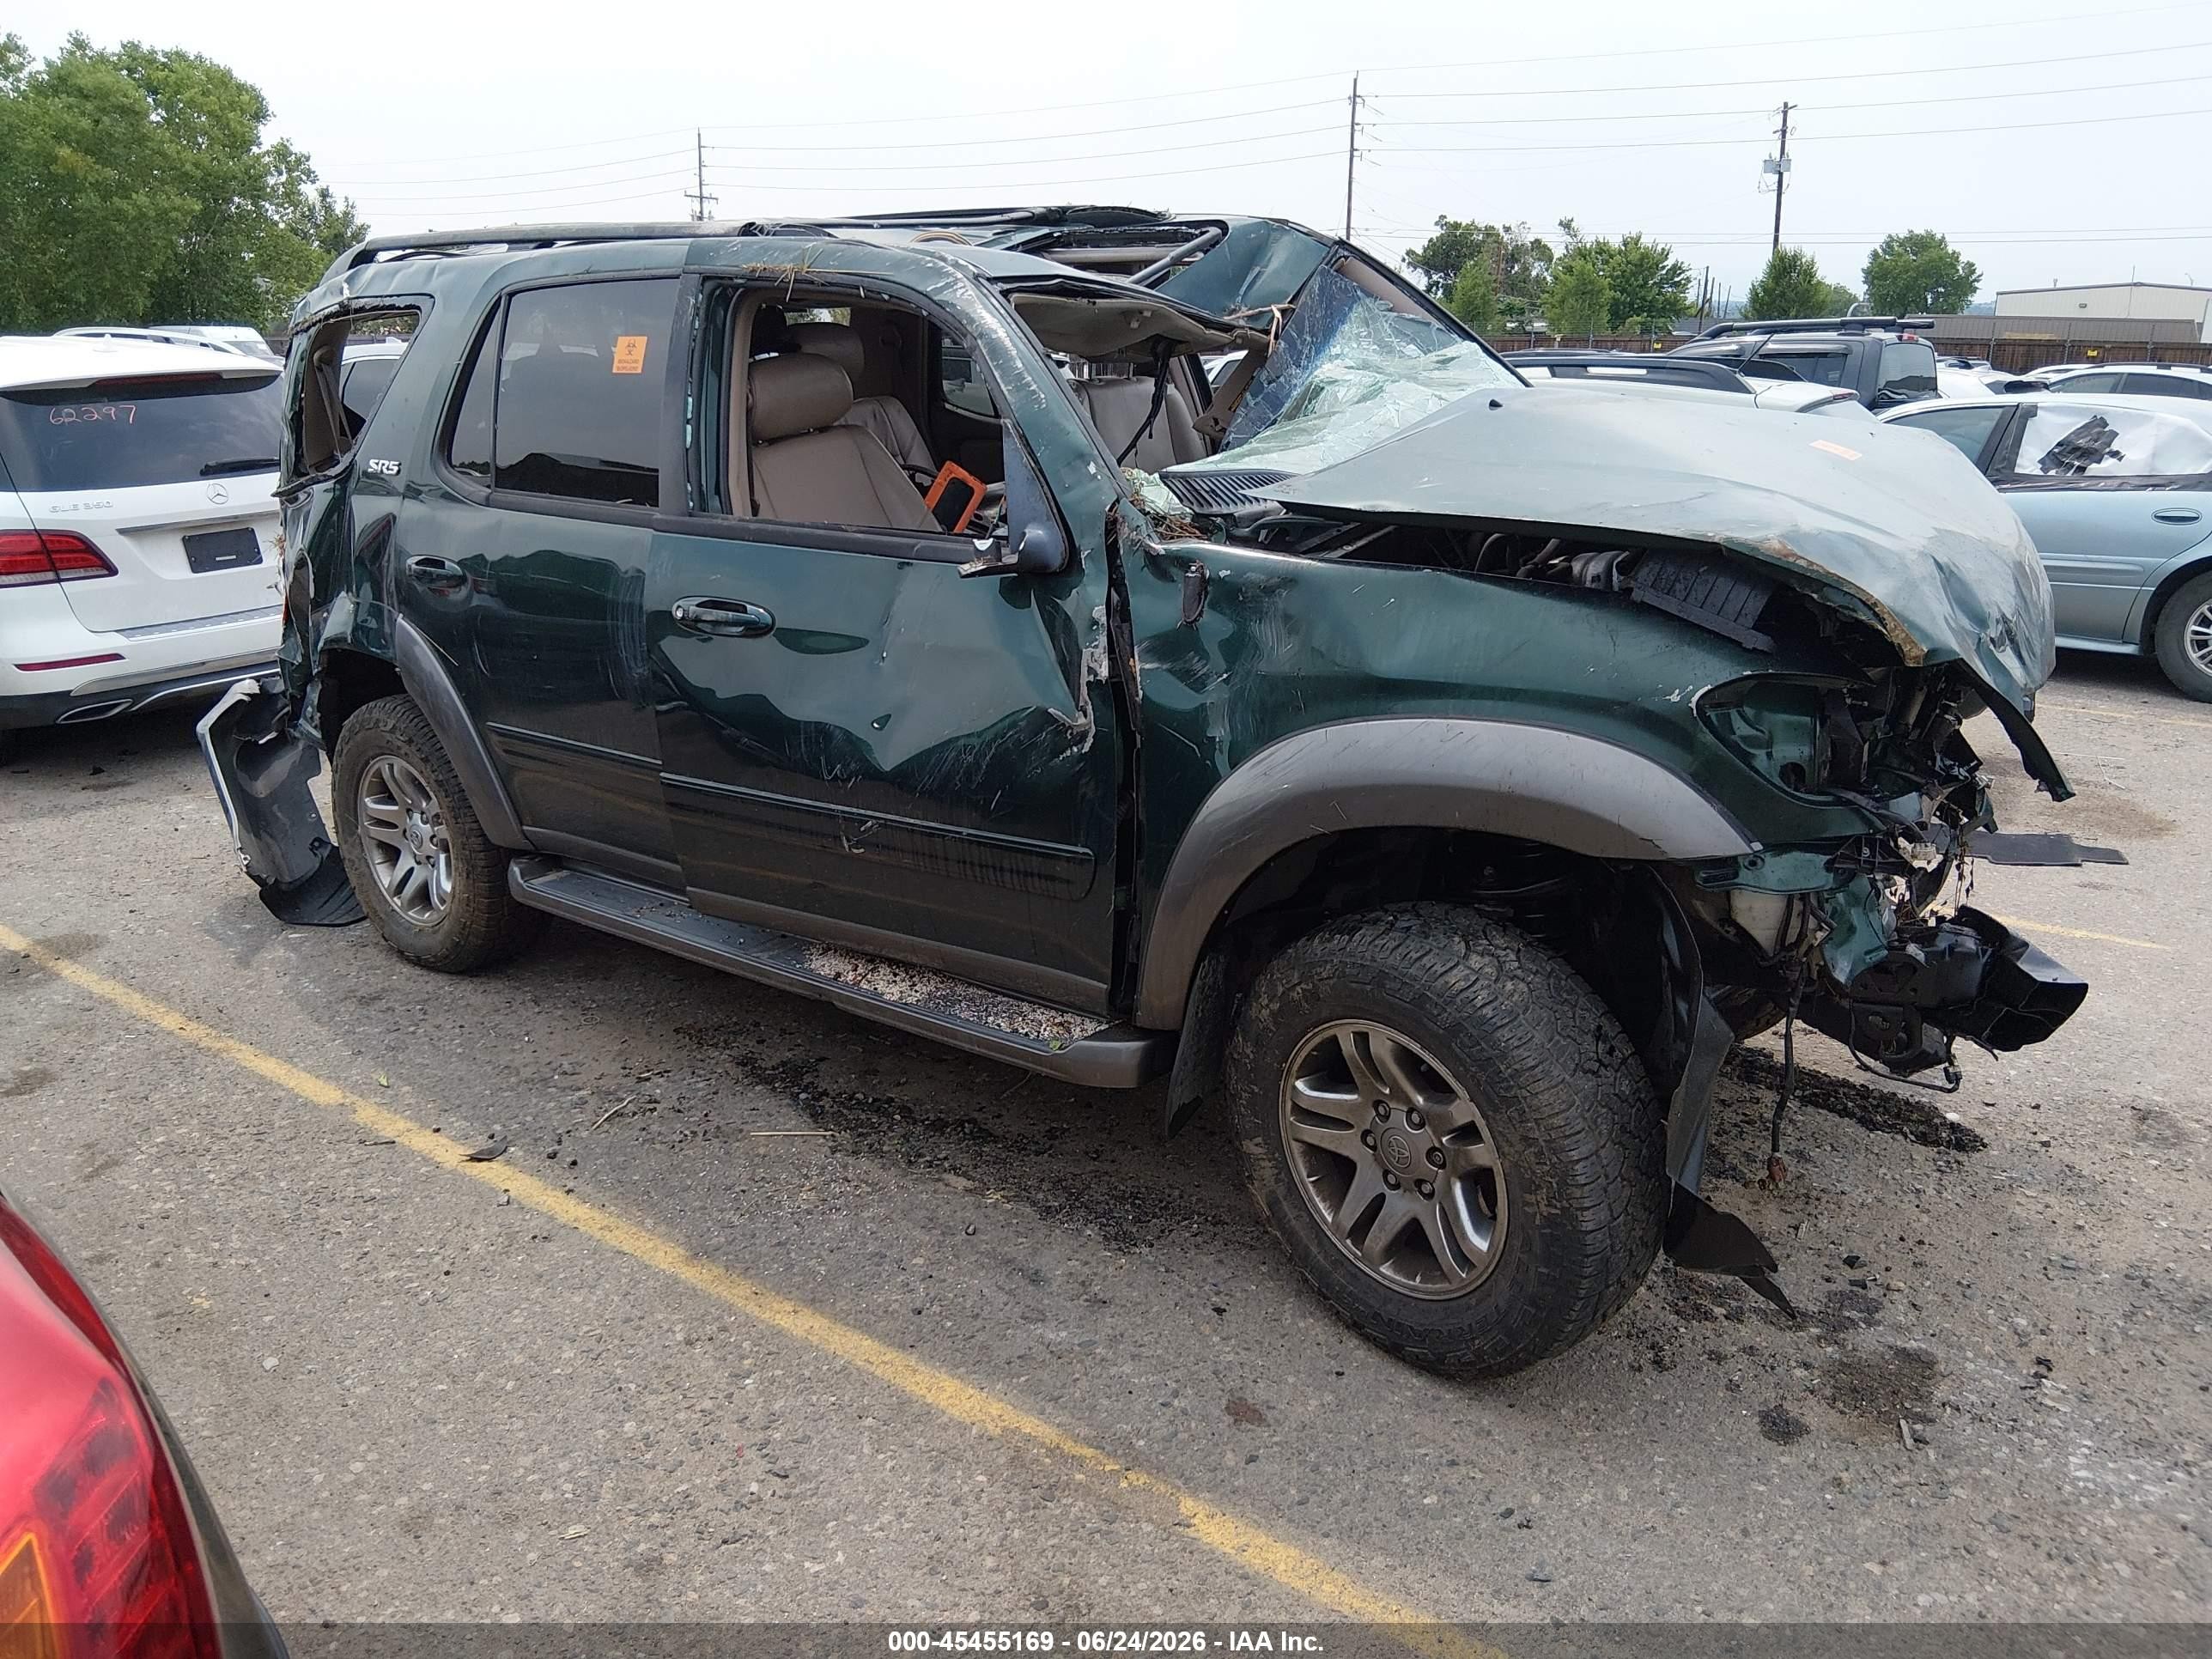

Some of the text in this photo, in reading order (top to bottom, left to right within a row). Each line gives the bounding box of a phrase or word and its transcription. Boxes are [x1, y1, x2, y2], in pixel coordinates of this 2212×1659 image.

[50, 404, 136, 425] 62297
[368, 459, 399, 474] SR5
[49, 501, 113, 513] GLE 350
